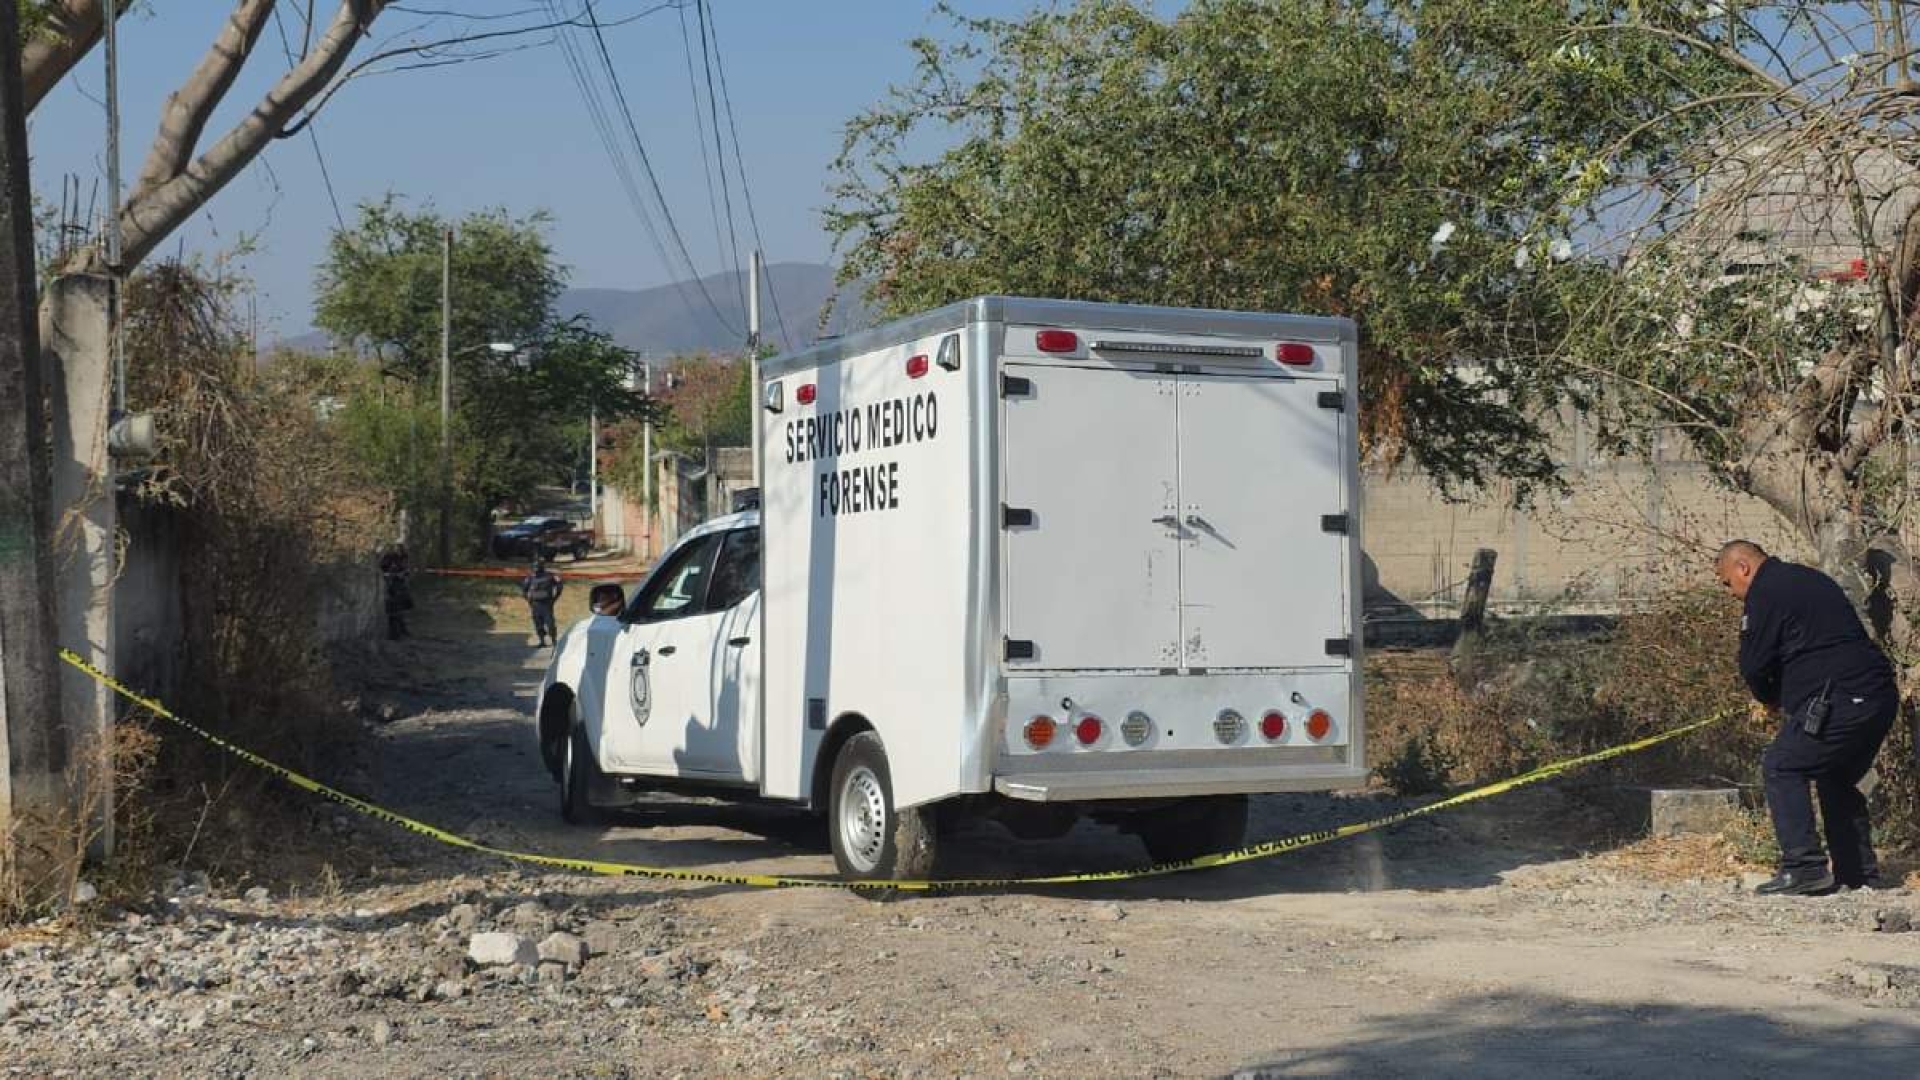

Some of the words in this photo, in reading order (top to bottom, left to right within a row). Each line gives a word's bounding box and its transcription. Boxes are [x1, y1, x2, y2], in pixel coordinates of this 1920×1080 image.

[786, 408, 861, 464] SERVICIO
[867, 391, 937, 450] MEDICO
[820, 462, 898, 517] FORENSE
